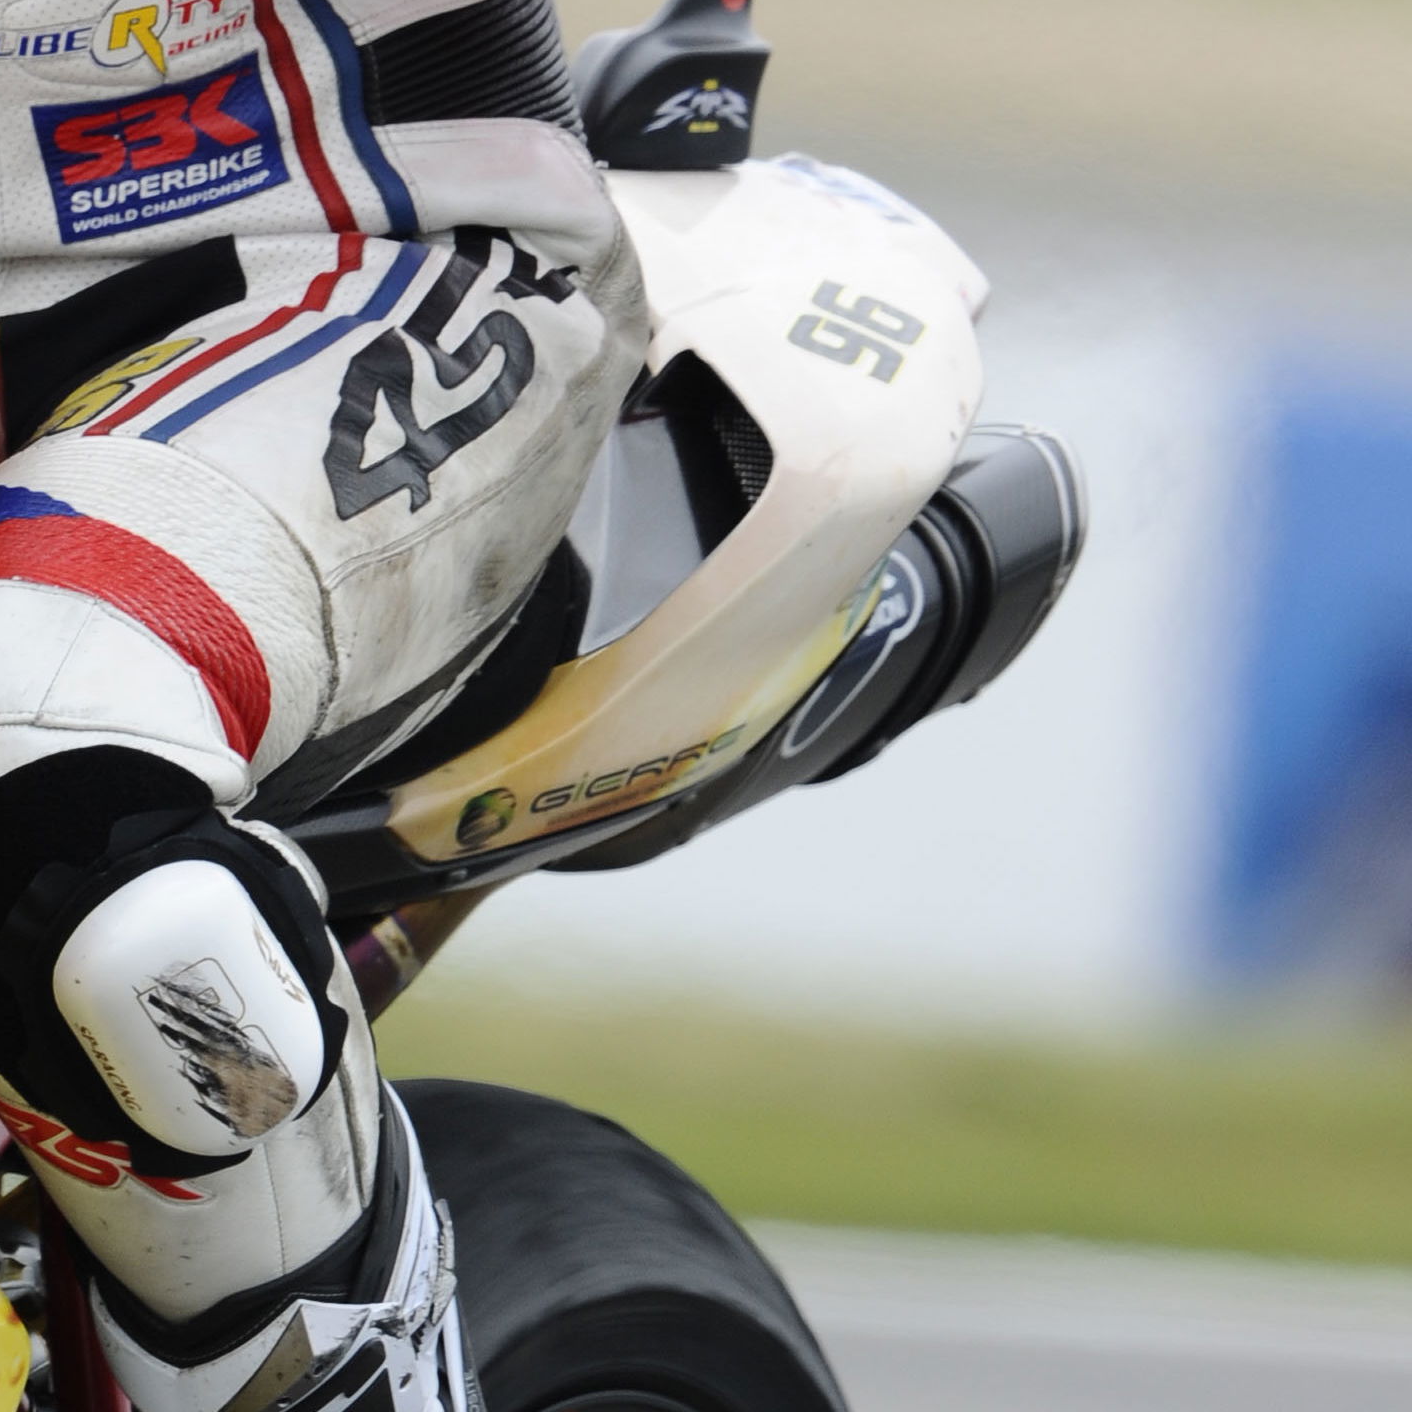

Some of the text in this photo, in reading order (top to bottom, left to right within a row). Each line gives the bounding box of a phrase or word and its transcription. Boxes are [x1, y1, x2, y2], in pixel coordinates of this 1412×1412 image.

[53, 73, 260, 187] SBK
[69, 143, 265, 215] SUPERBIKE
[72, 168, 272, 234] WORLD CHAMPIONSHIP
[786, 279, 926, 385] 96
